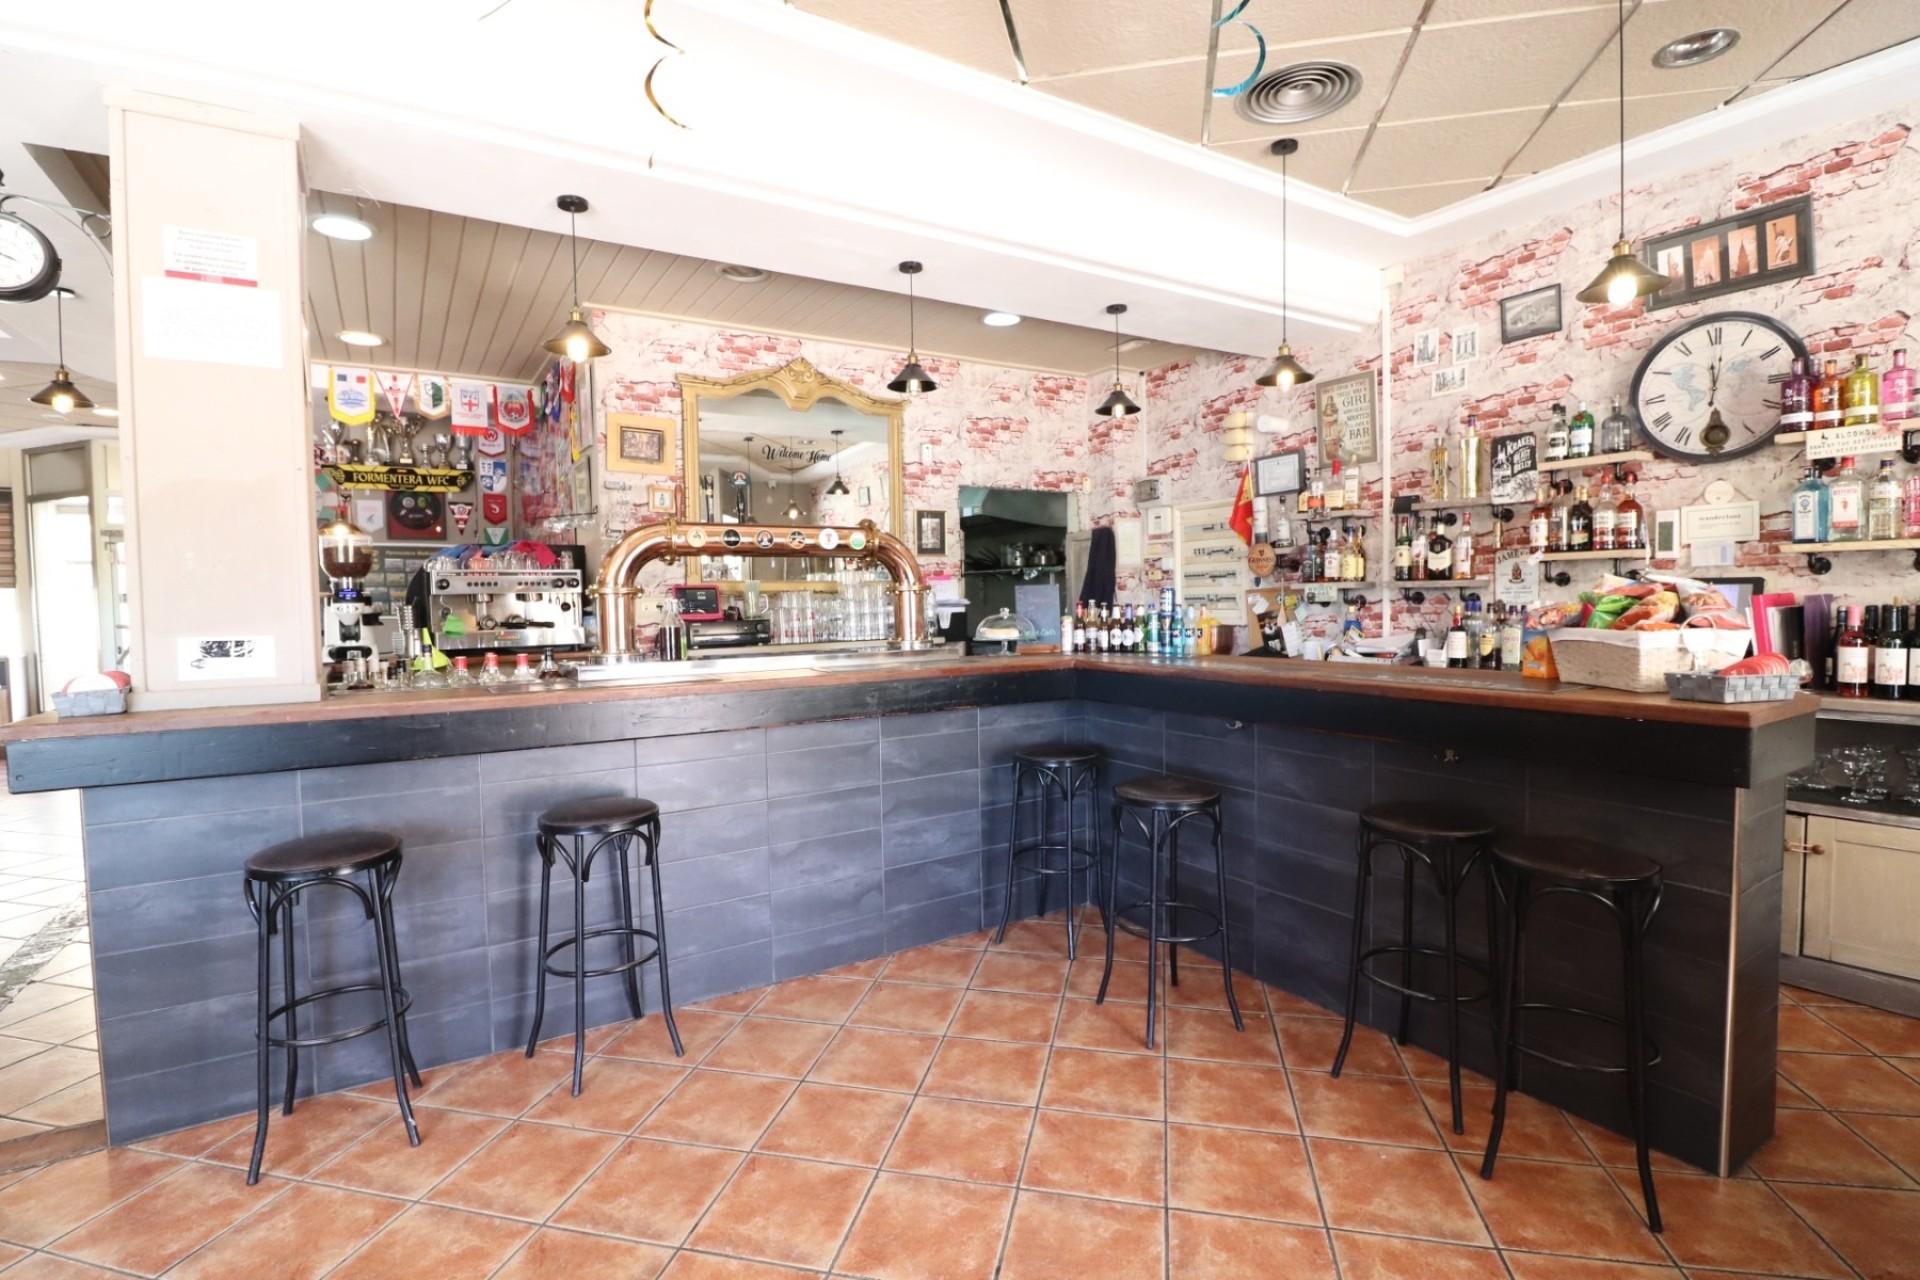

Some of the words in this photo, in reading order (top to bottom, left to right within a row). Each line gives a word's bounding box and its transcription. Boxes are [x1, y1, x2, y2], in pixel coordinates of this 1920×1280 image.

[1342, 393, 1370, 408] GIRL
[1349, 427, 1370, 441] BAR
[762, 444, 803, 460] Welcome
[806, 448, 832, 463] Home
[353, 472, 423, 485] FORMENTERA
[427, 476, 450, 486] WFC
